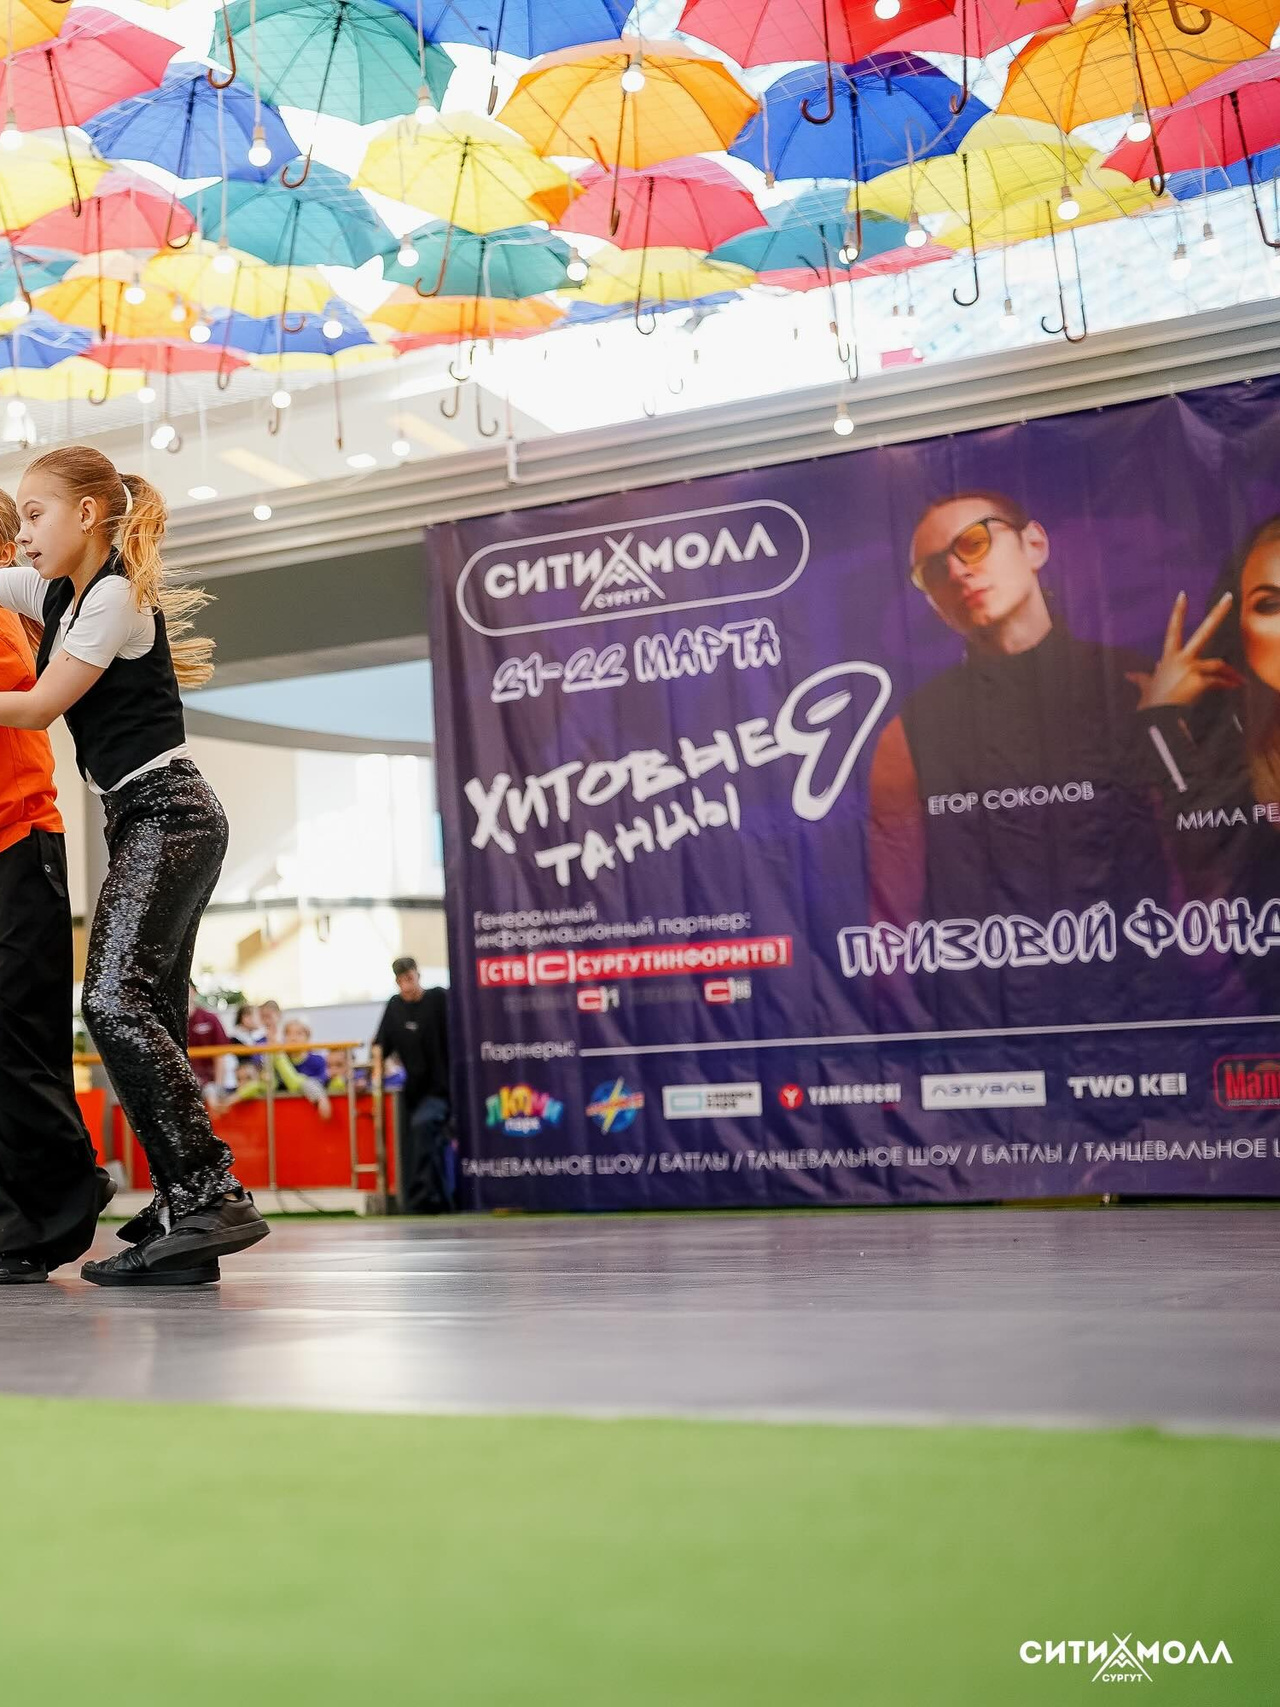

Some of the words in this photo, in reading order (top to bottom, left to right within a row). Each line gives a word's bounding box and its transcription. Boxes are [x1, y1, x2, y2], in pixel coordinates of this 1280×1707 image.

[490, 643, 629, 703] 21-22
[633, 617, 780, 683] МАРТА
[464, 717, 785, 854] ХИТОВЫЕ
[927, 791, 978, 815] ЕГОР
[982, 781, 1094, 810] СОКОЛОВ
[534, 781, 740, 887] ТАНЦЫ
[1176, 807, 1247, 831] МИЛА
[474, 901, 598, 931] Генеральный
[837, 901, 1116, 978] ПРИЗОВОЙ
[807, 1083, 902, 1105] YAMAGUCHI
[1067, 1074, 1134, 1099] TWO
[1139, 1073, 1187, 1096] KEI
[461, 1155, 594, 1177] ТАНЦЕВАЛЬНОЕ
[596, 1154, 644, 1175] ШОУ
[746, 1146, 904, 1171] ТАНЦЕВАЛЬНОЕ
[907, 1144, 962, 1166] ШОУ
[981, 1142, 1062, 1164] БАТТЛЫ
[1082, 1138, 1268, 1163] ТАНЦЕВАЛЬНОЕ
